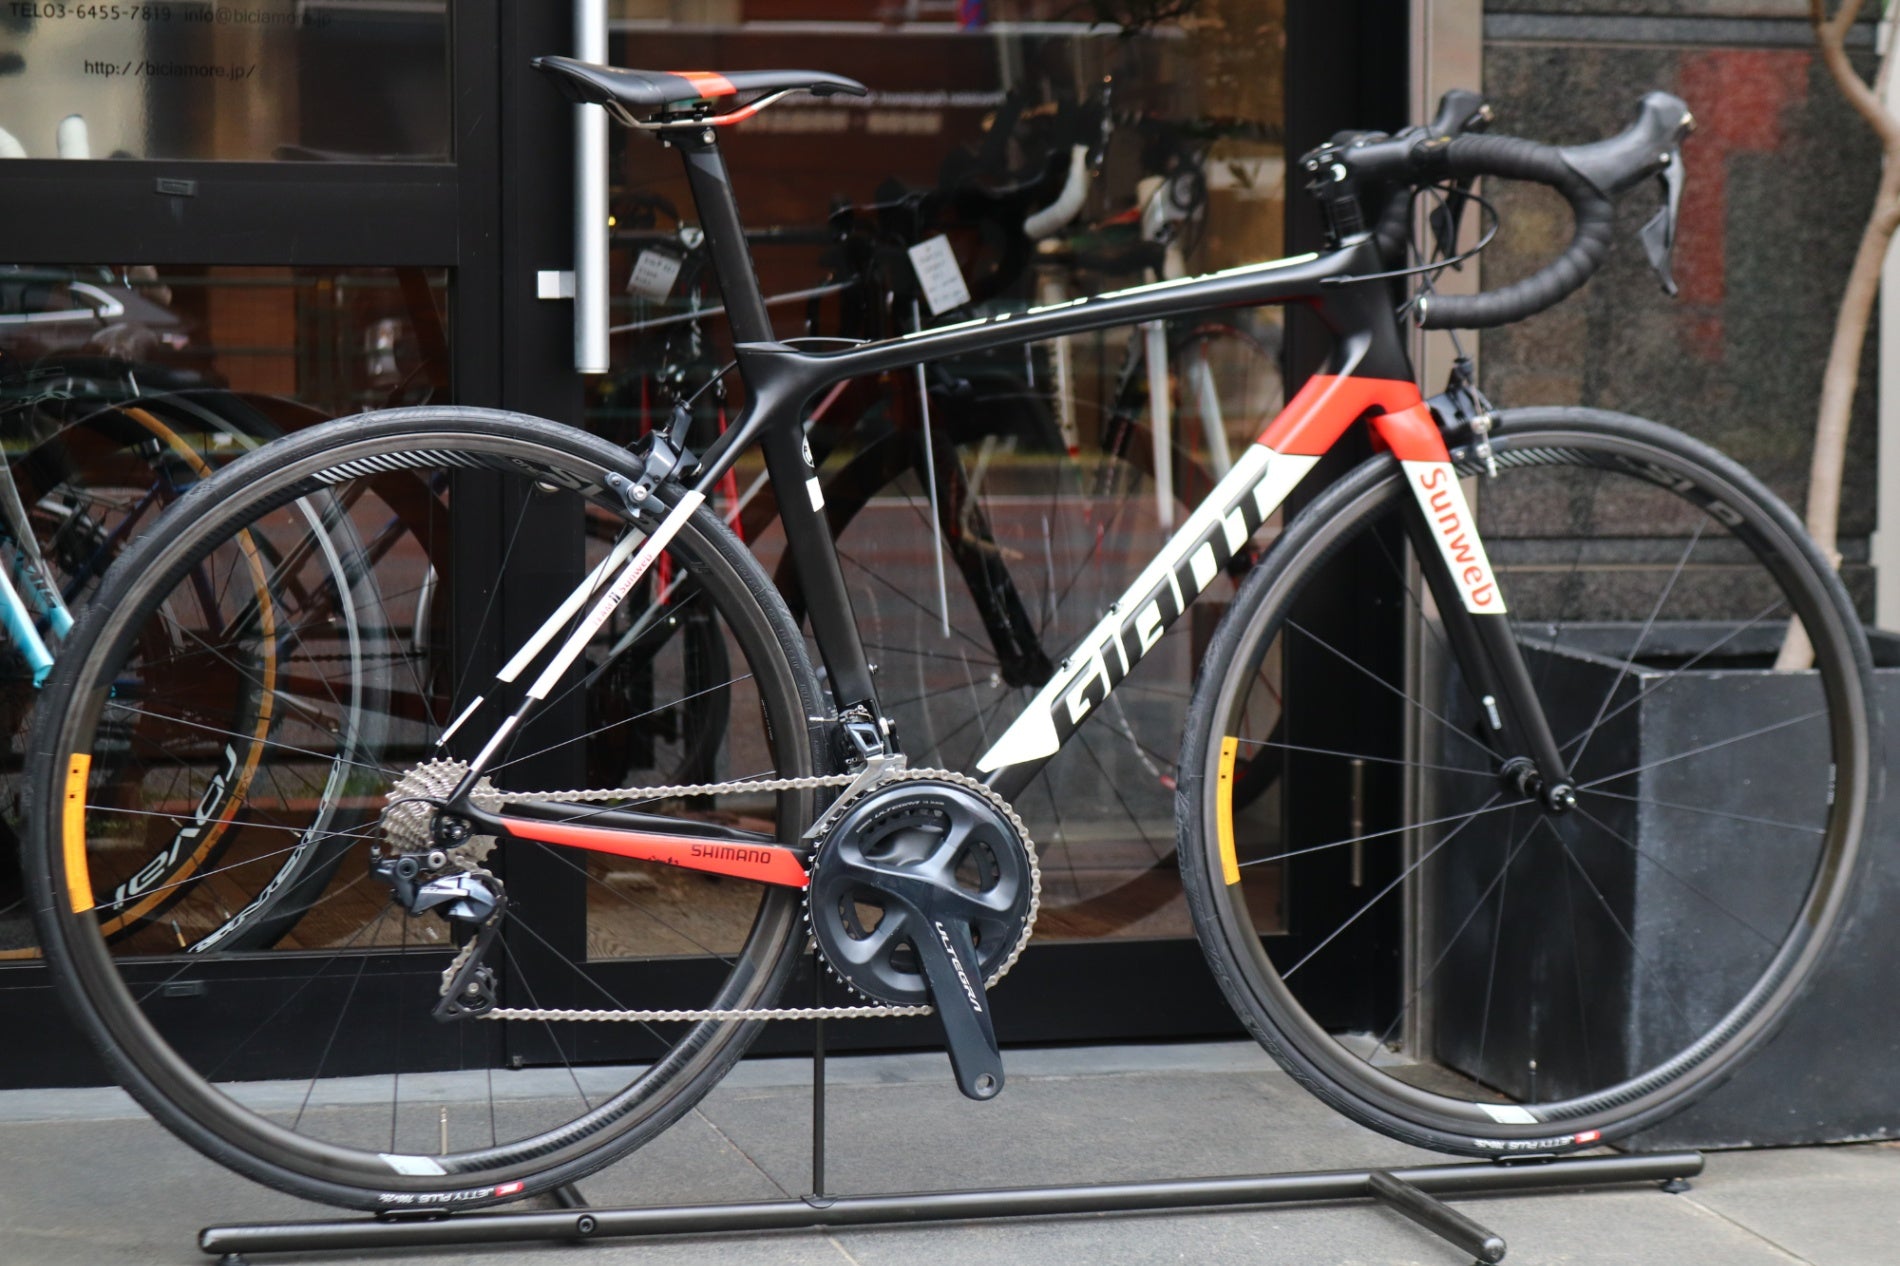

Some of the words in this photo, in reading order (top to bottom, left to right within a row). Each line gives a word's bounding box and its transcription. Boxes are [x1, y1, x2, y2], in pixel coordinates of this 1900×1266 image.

[1419, 467, 1495, 607] Sunweb
[619, 553, 652, 594] Sunweb
[691, 844, 772, 864] SHIMANO
[935, 921, 983, 1012] ULTEGRA
